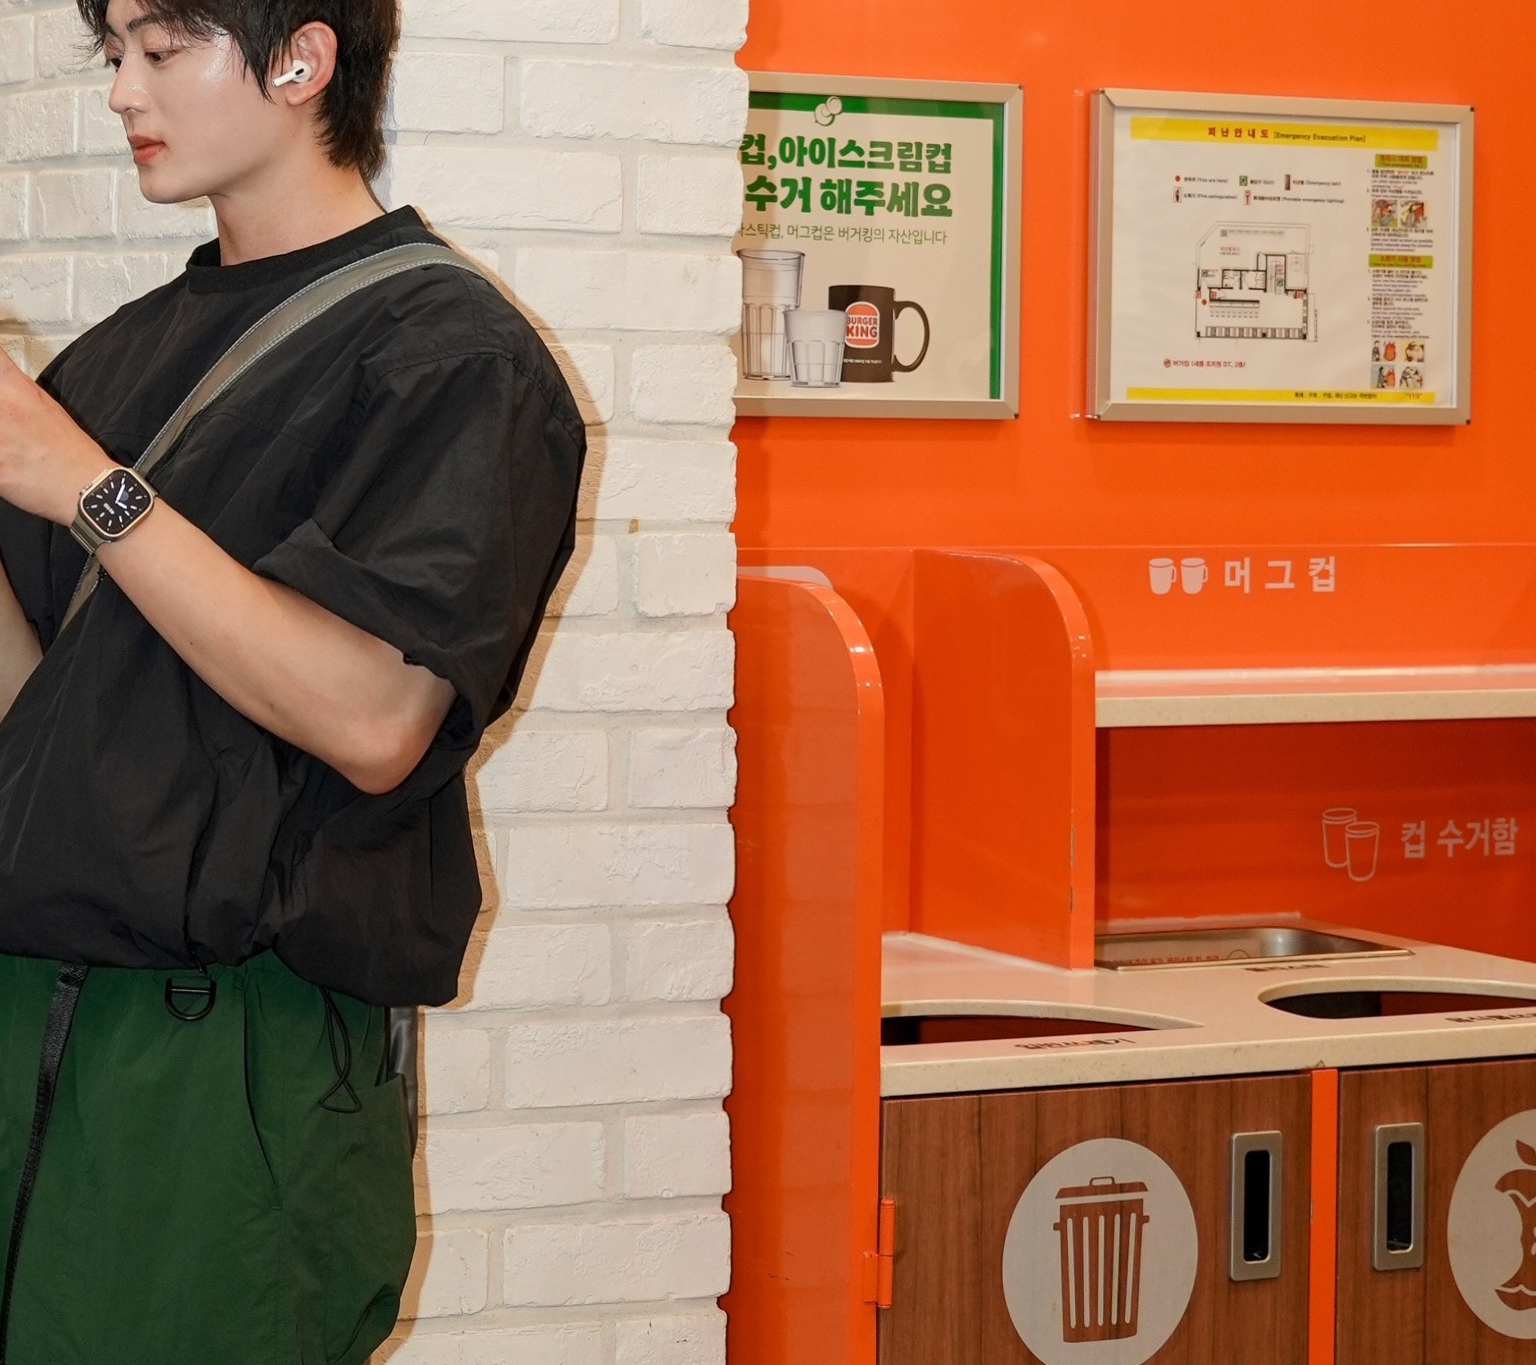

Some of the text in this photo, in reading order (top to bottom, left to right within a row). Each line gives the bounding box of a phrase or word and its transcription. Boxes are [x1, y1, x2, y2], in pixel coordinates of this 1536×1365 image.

[745, 175, 953, 217] 수거 해주세요
[787, 225, 835, 241] 머그컵은
[838, 227, 885, 243] 버거킹의
[888, 228, 948, 246] 자산입니다
[847, 317, 878, 325] BURGER
[846, 326, 878, 338] KING
[1401, 817, 1520, 859] 컵 수거함
